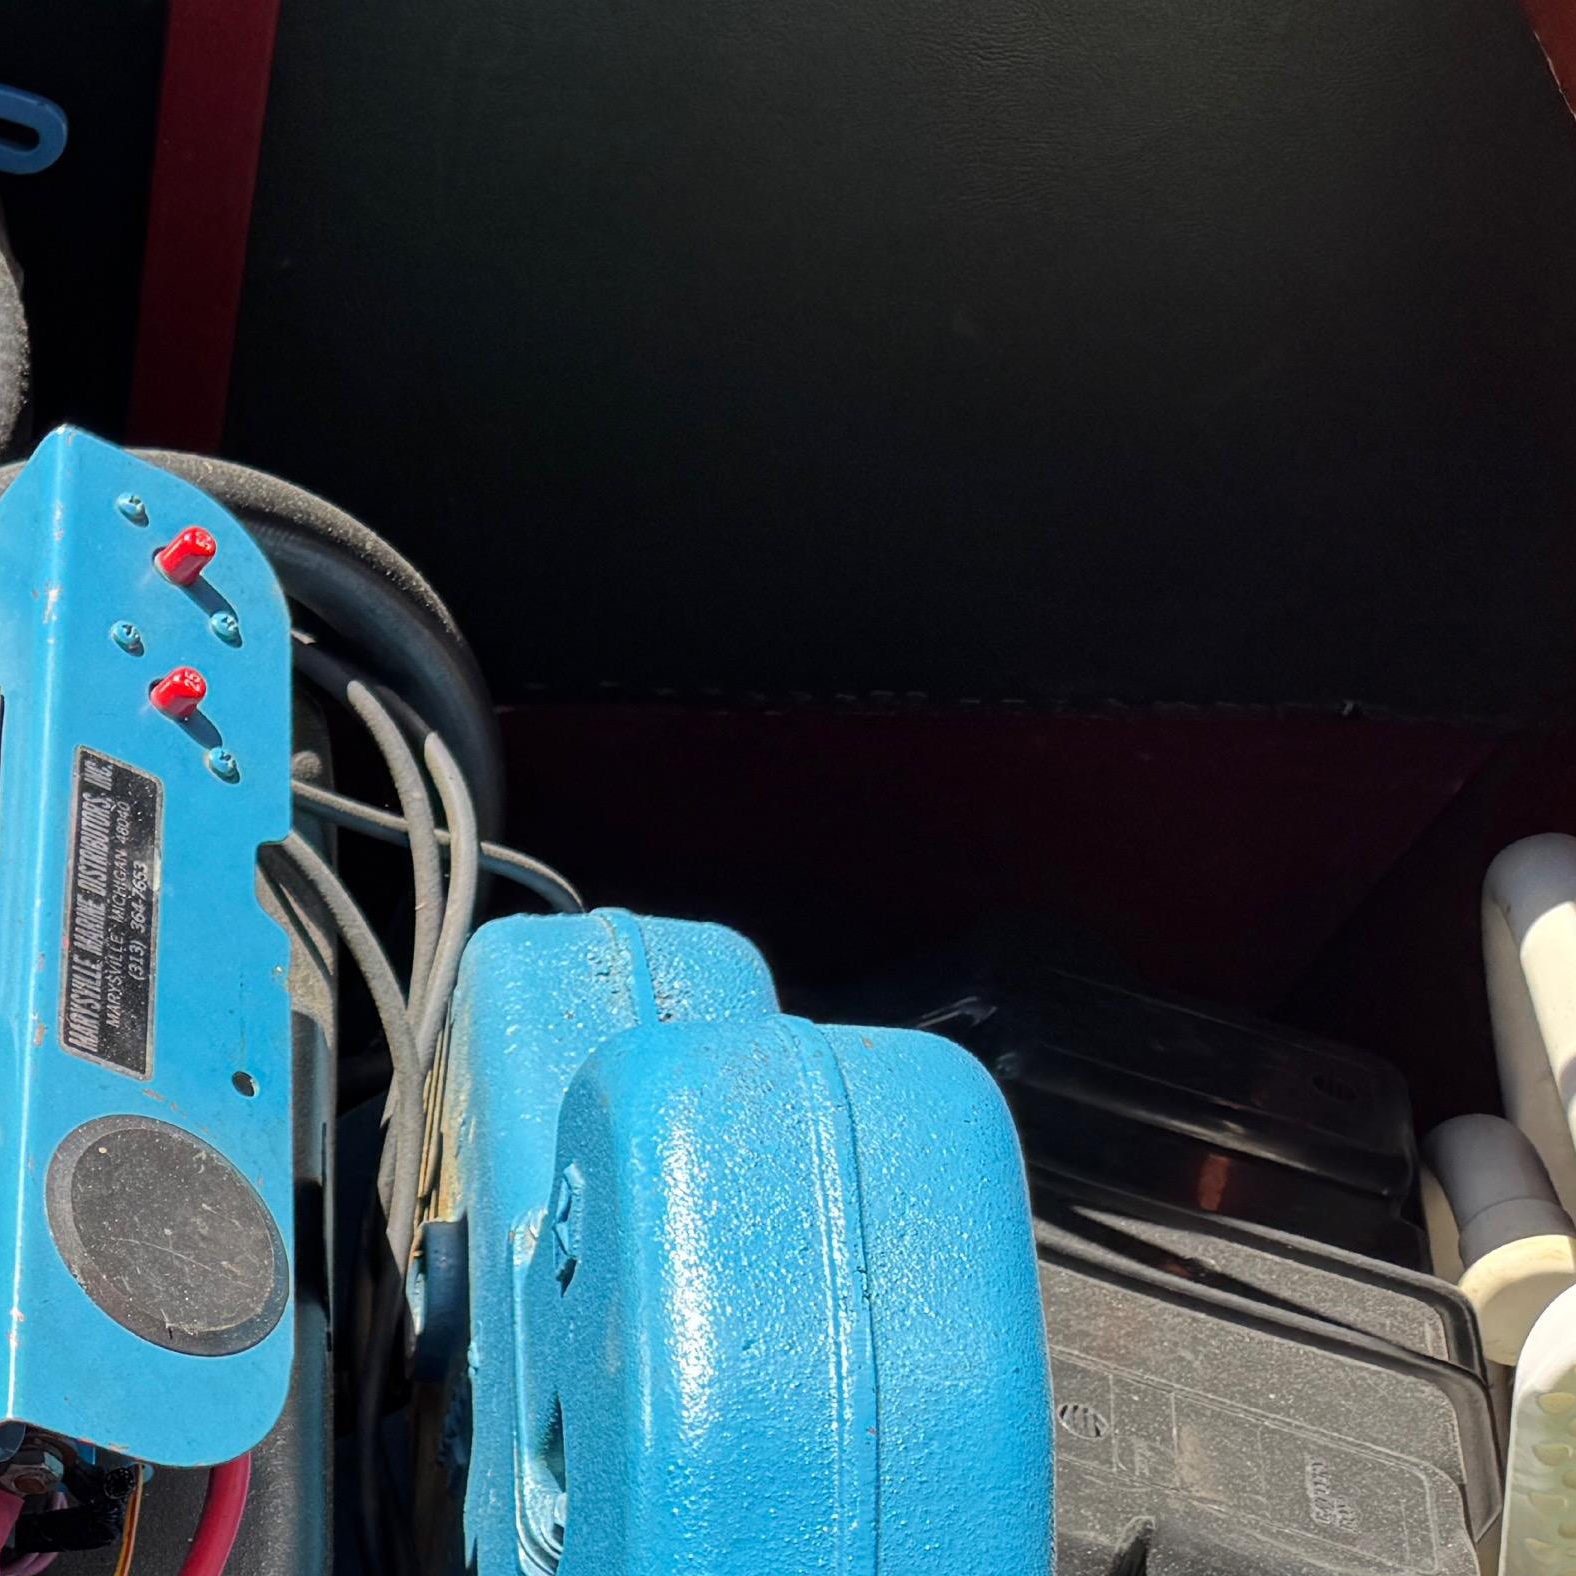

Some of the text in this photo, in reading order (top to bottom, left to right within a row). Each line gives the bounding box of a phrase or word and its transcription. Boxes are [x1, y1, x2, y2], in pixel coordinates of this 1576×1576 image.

[69, 760, 115, 1053] MARYSVILLE MARINE DISTRIBUTORS, INC.
[111, 848, 130, 924] MICHIGAN
[129, 860, 149, 981] (313) 364-7653
[105, 928, 128, 1029] MARYSVILLE,
